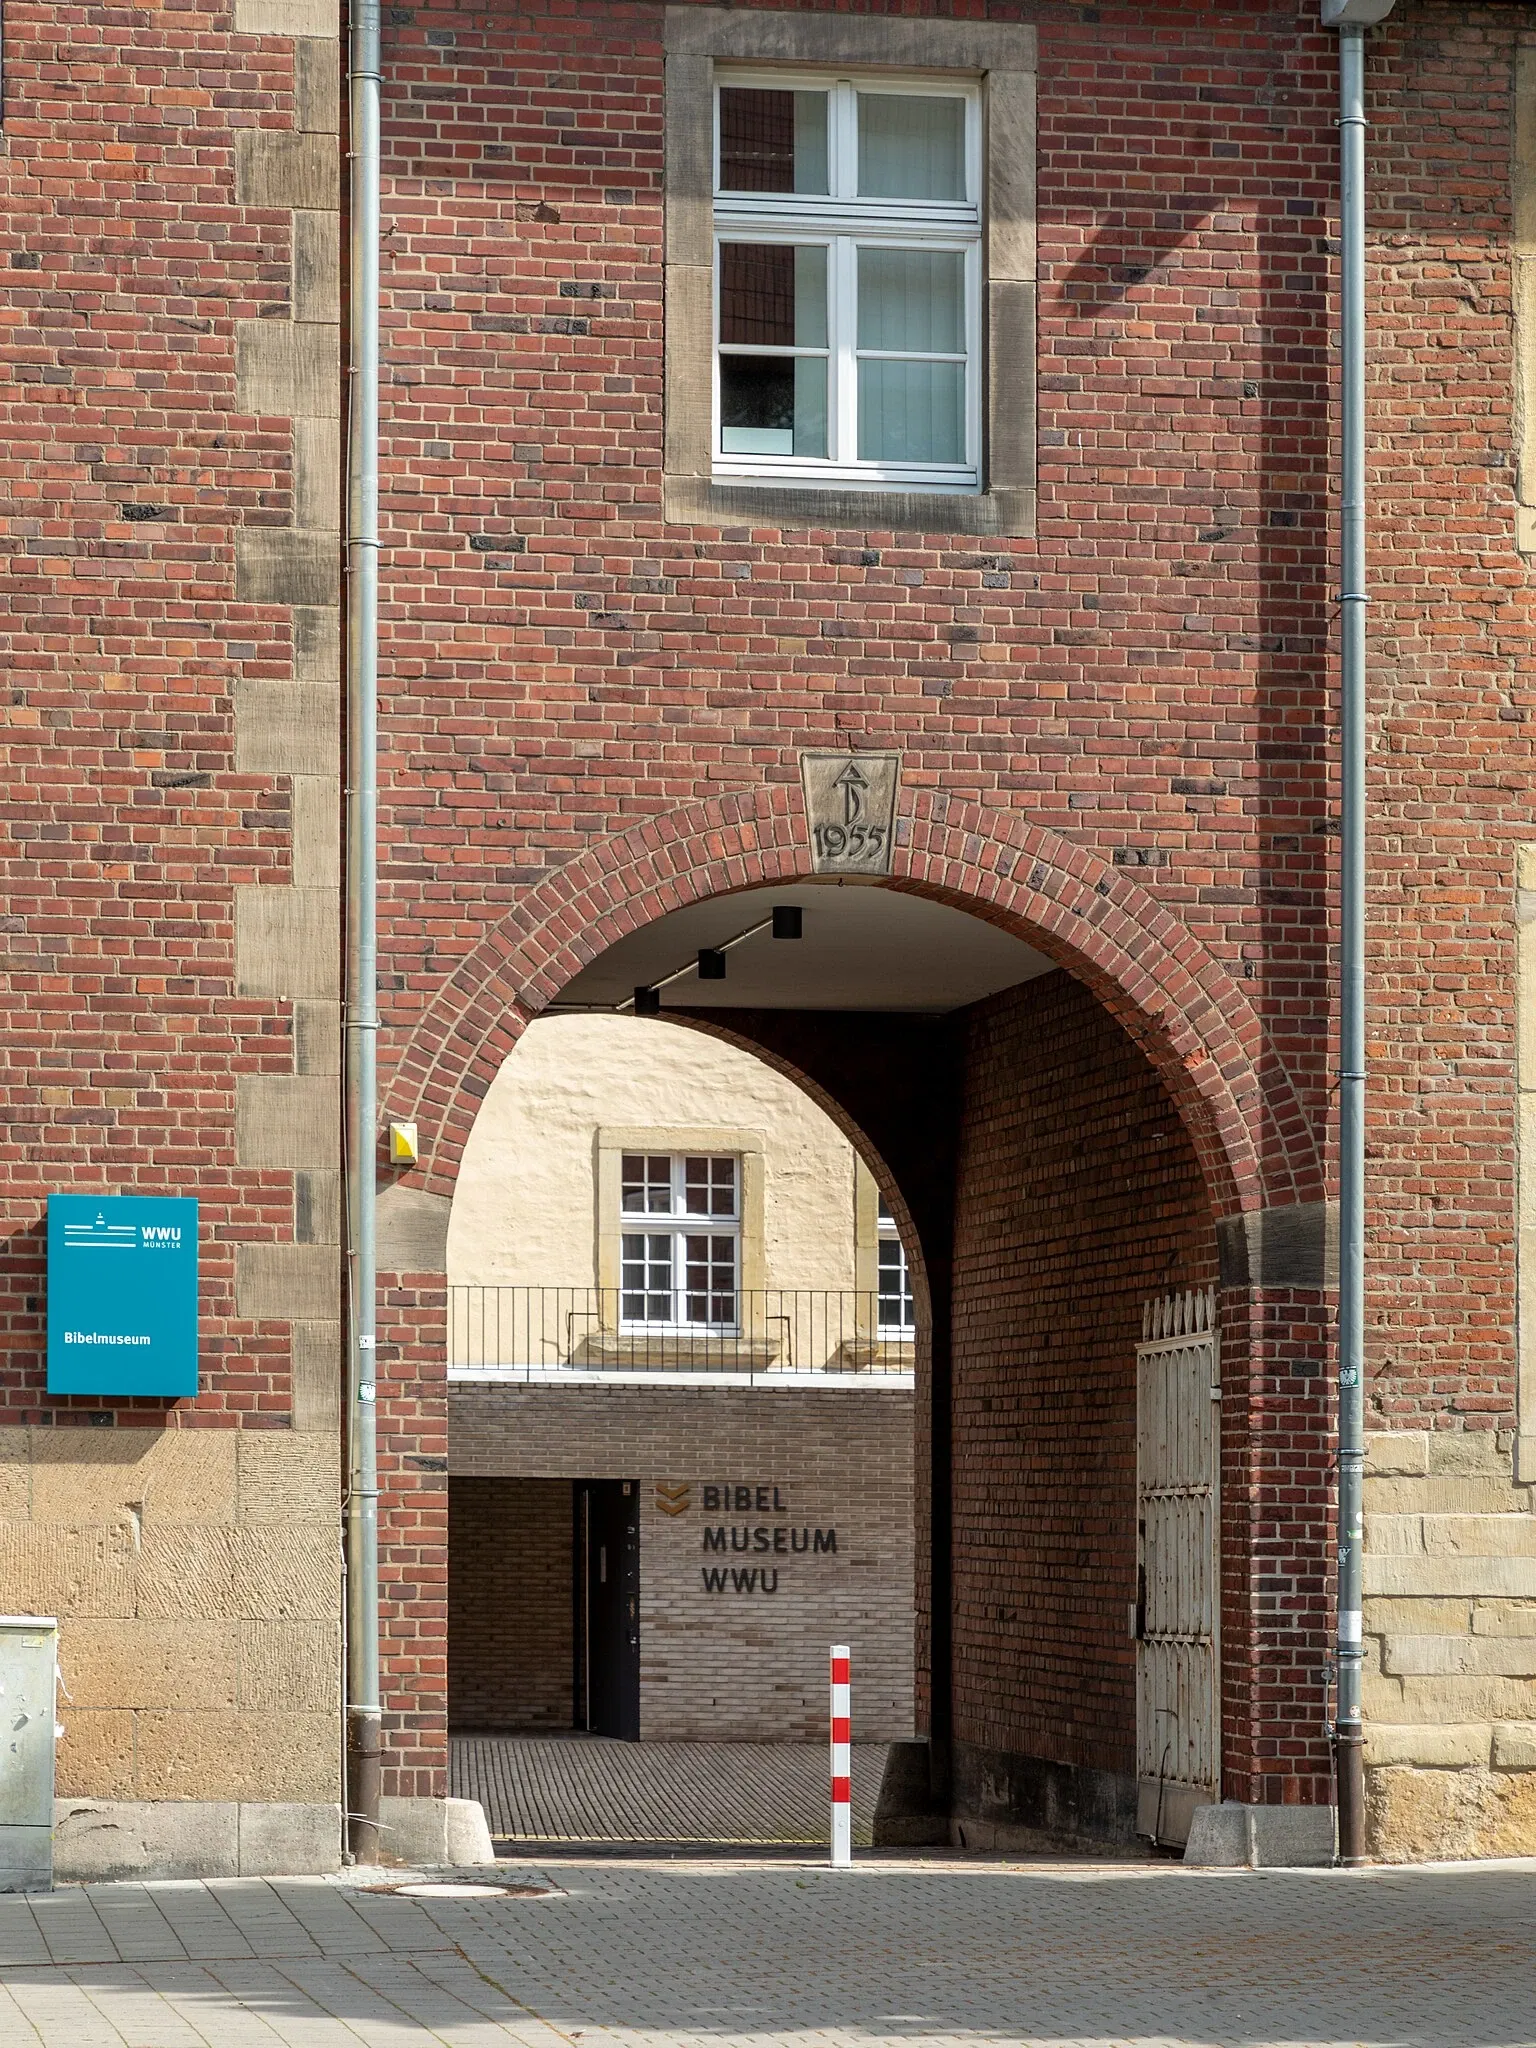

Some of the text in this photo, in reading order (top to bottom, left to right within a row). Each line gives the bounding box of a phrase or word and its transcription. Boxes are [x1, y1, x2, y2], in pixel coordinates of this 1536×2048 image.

[813, 823, 887, 858] 1955
[141, 1226, 181, 1240] WWU
[142, 1240, 181, 1249] MÜNSTER
[64, 1331, 151, 1345] Bibelmuseum
[703, 1485, 787, 1512] BIBEL
[703, 1526, 838, 1554] MUSEUM
[702, 1567, 779, 1593] WWU
